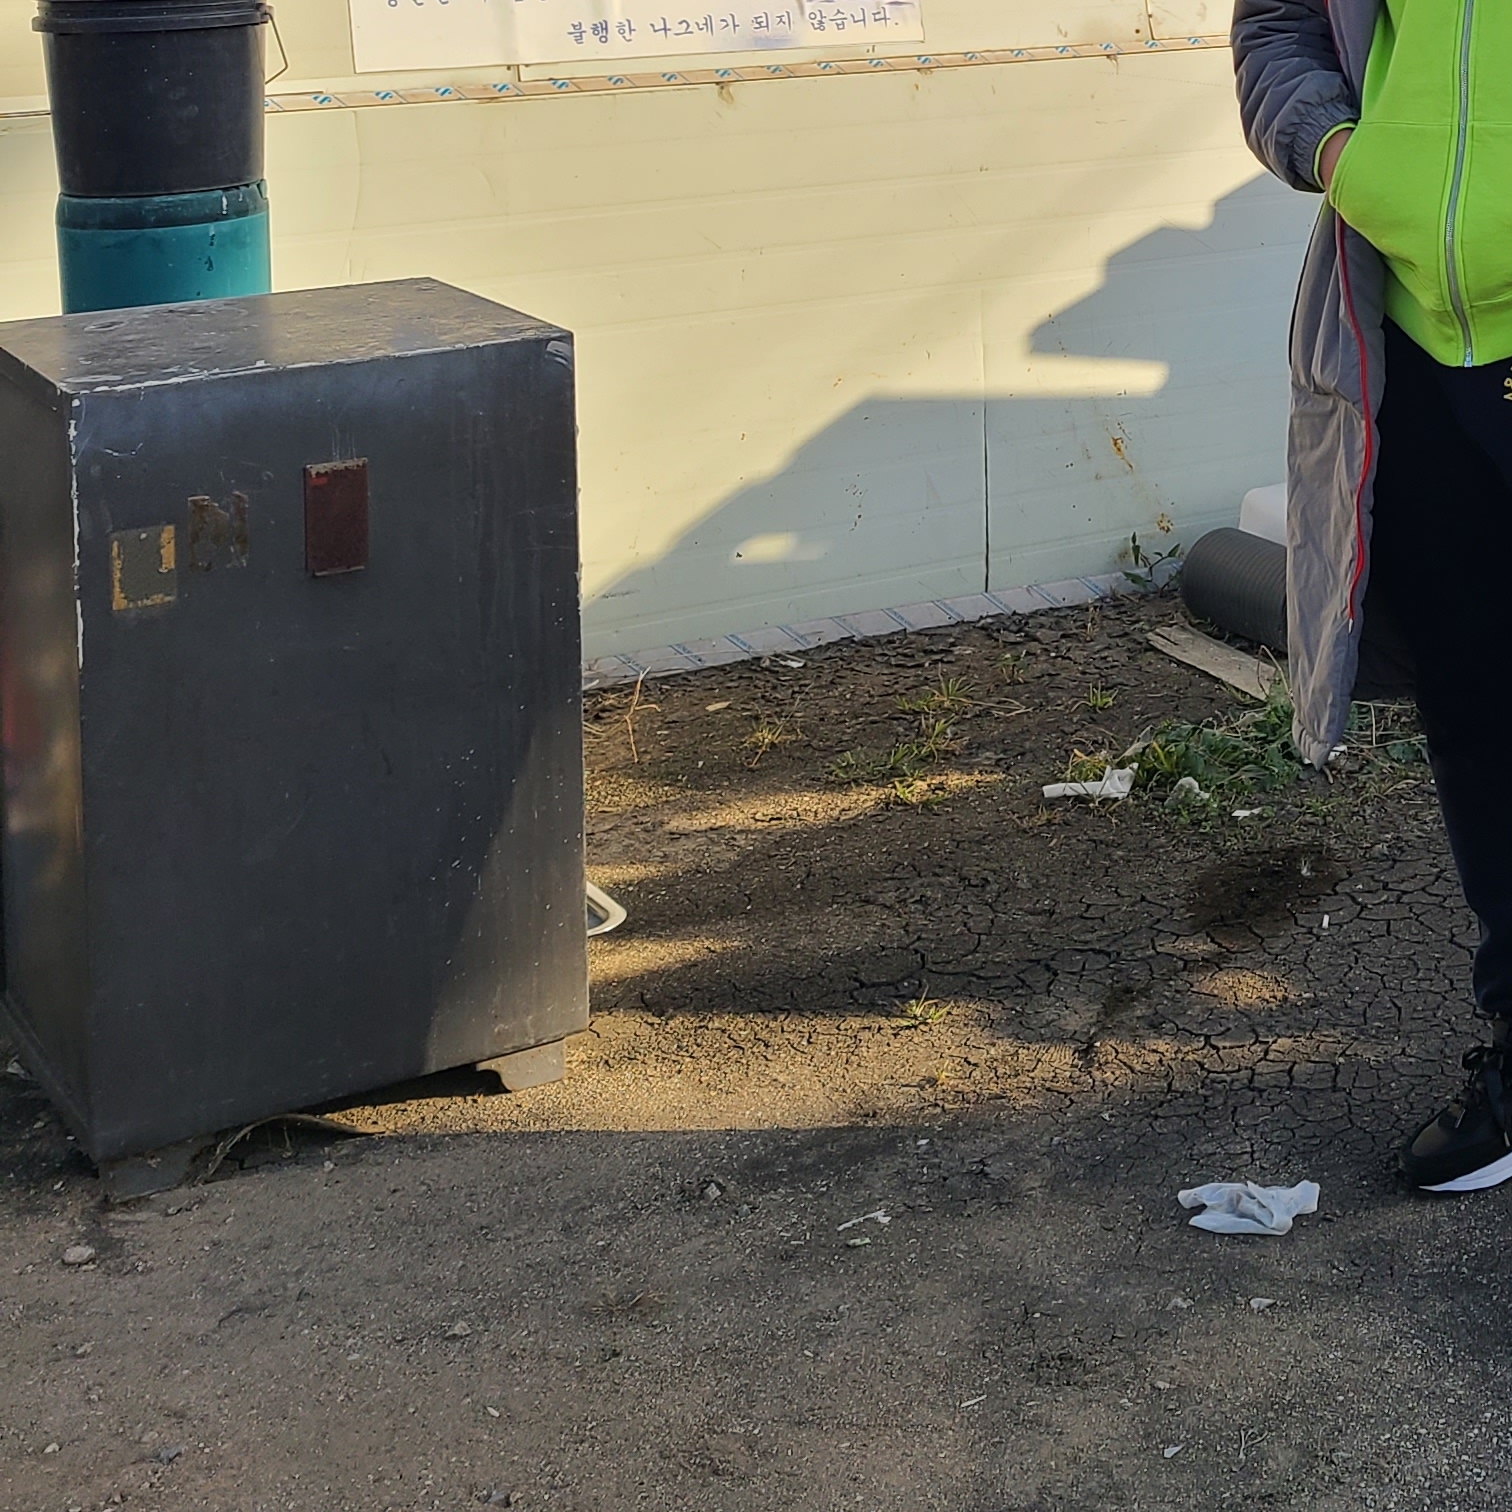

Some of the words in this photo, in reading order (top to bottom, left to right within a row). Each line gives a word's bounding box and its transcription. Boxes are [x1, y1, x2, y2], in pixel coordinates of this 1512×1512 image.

[567, 18, 637, 45] 불행한
[650, 14, 741, 39] 나그네가
[751, 11, 793, 34] 되지
[807, 7, 900, 32] 않습니다.
